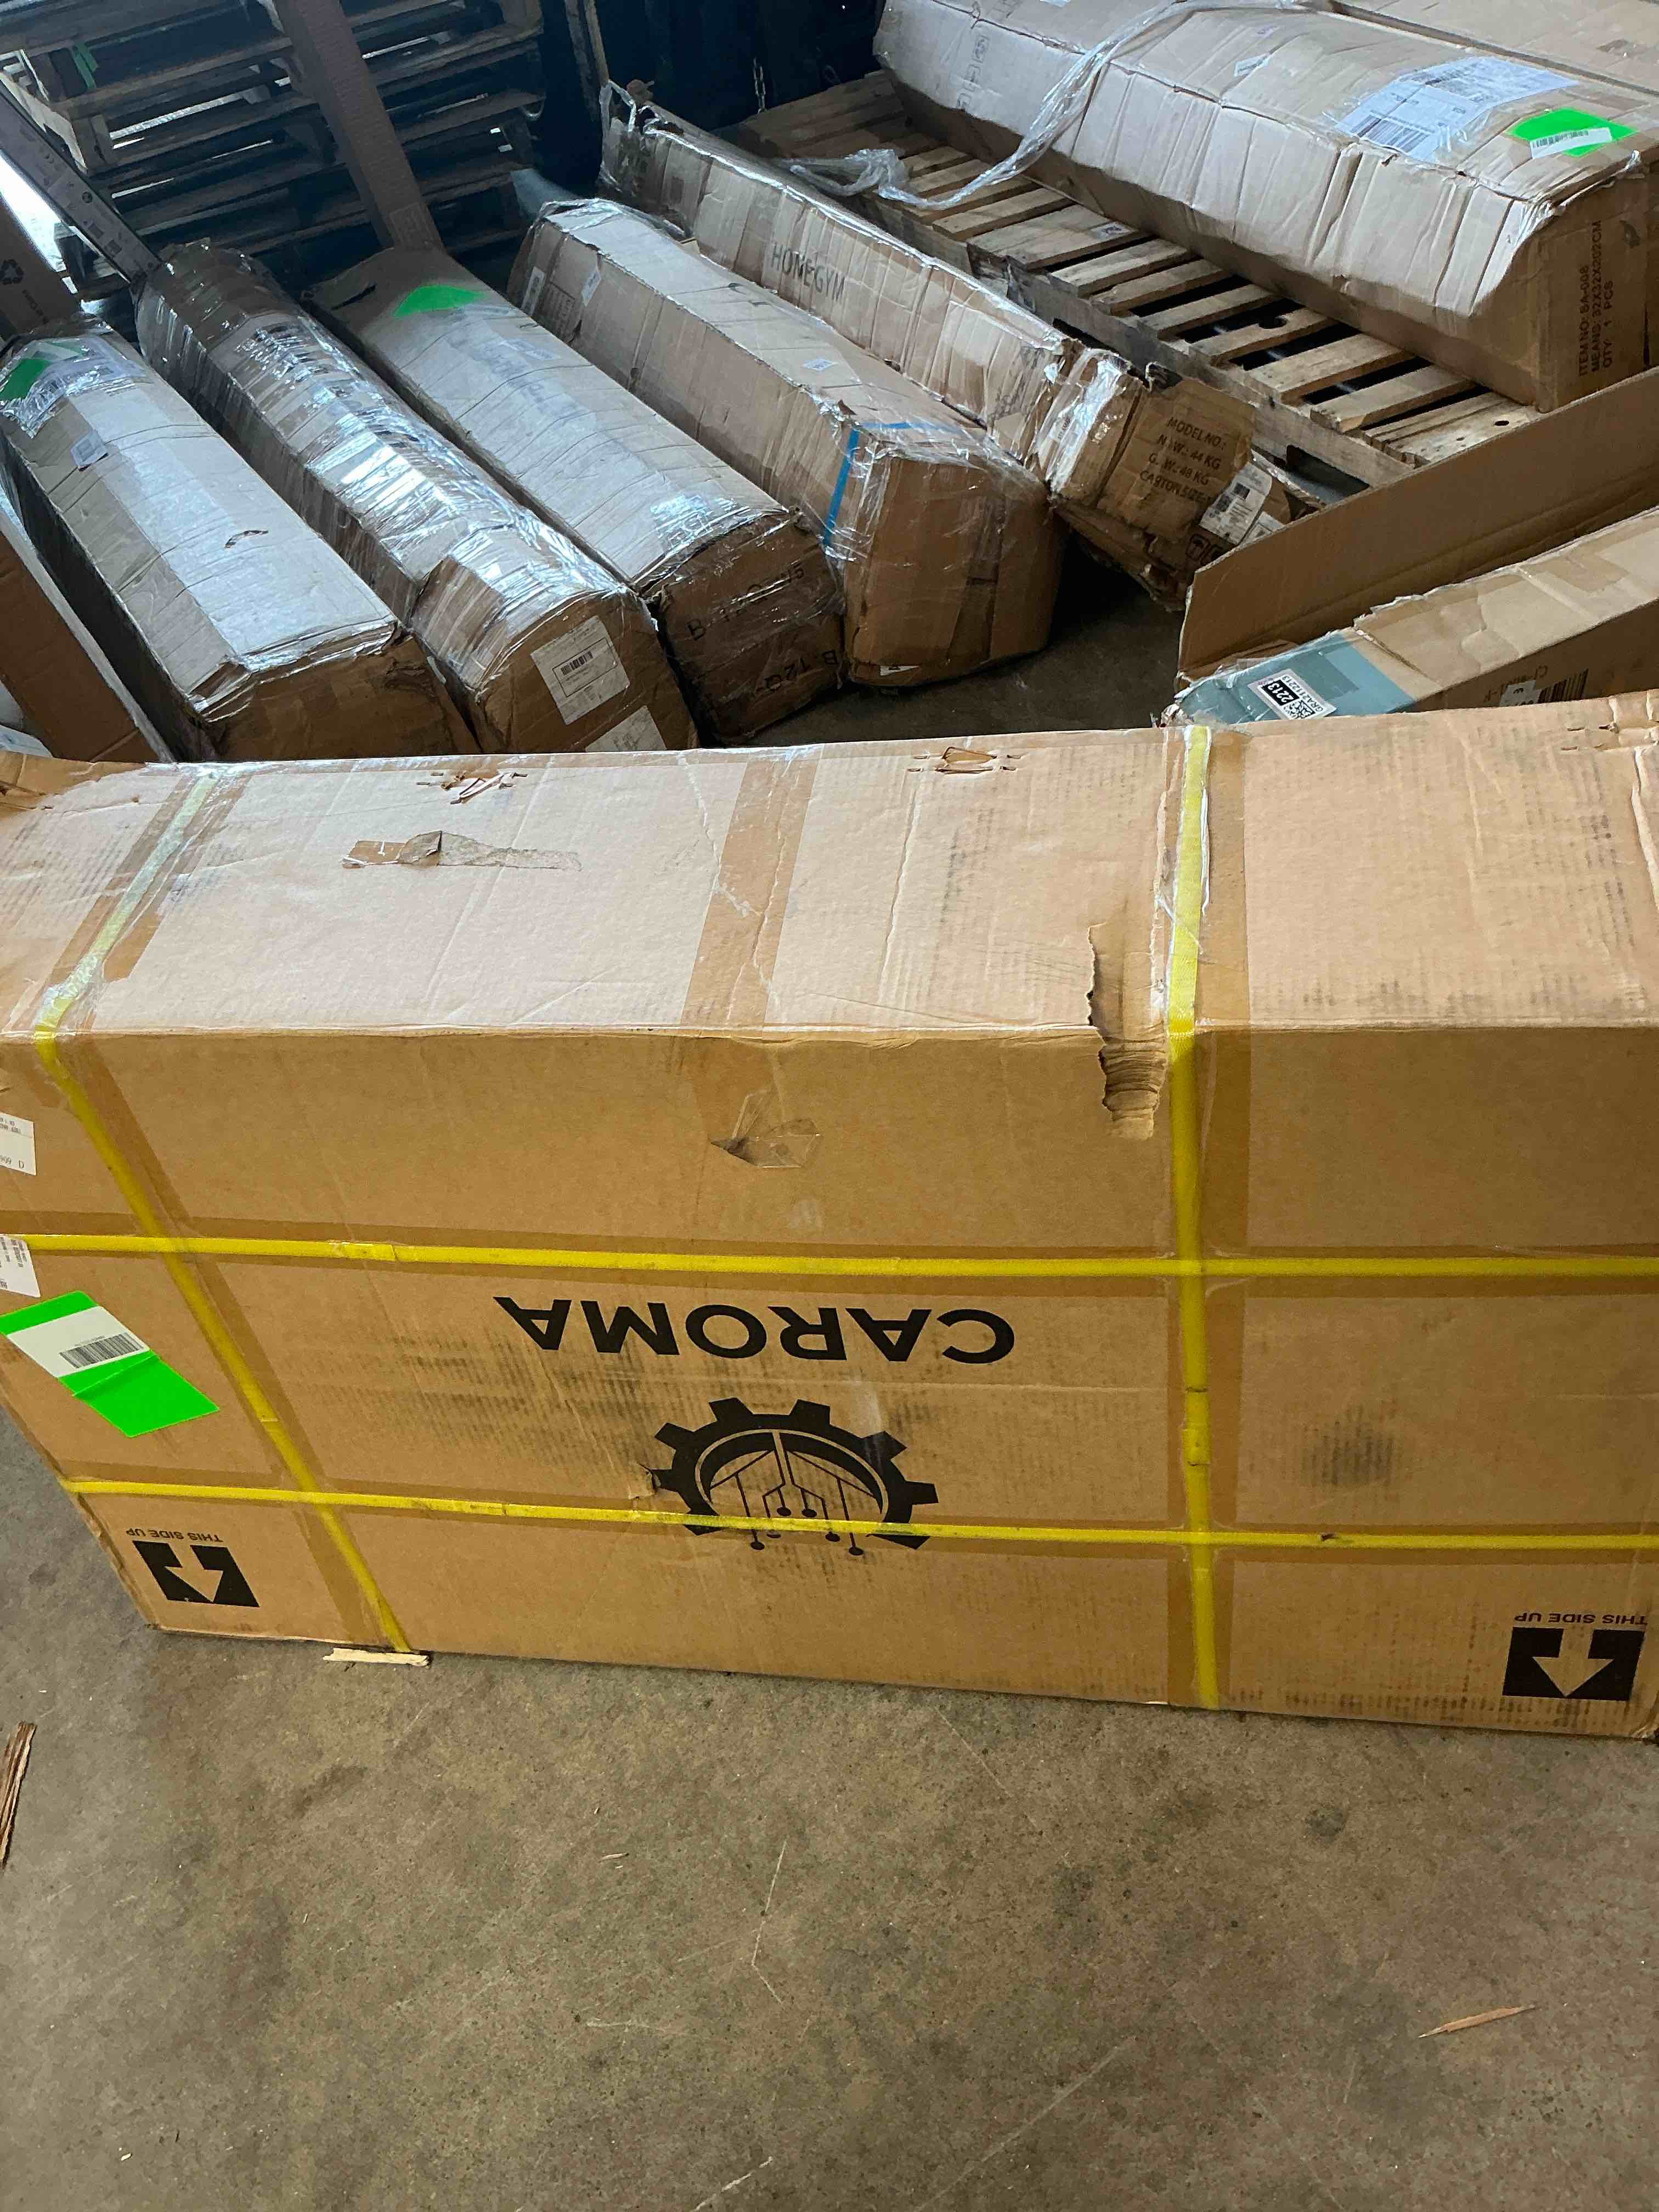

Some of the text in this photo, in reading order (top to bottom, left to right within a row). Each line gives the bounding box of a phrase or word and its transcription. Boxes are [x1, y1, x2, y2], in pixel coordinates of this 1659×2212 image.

[1604, 280, 1613, 309] PCS
[1167, 417, 1203, 441] MODEL
[1204, 455, 1221, 470] KG
[1193, 470, 1209, 486] KG
[1267, 682, 1294, 703] 2213
[492, 1296, 1015, 1364] CAROMA
[126, 1527, 224, 1543] THIS SIDE UP
[1514, 1612, 1648, 1626] THIS SIDE UP
